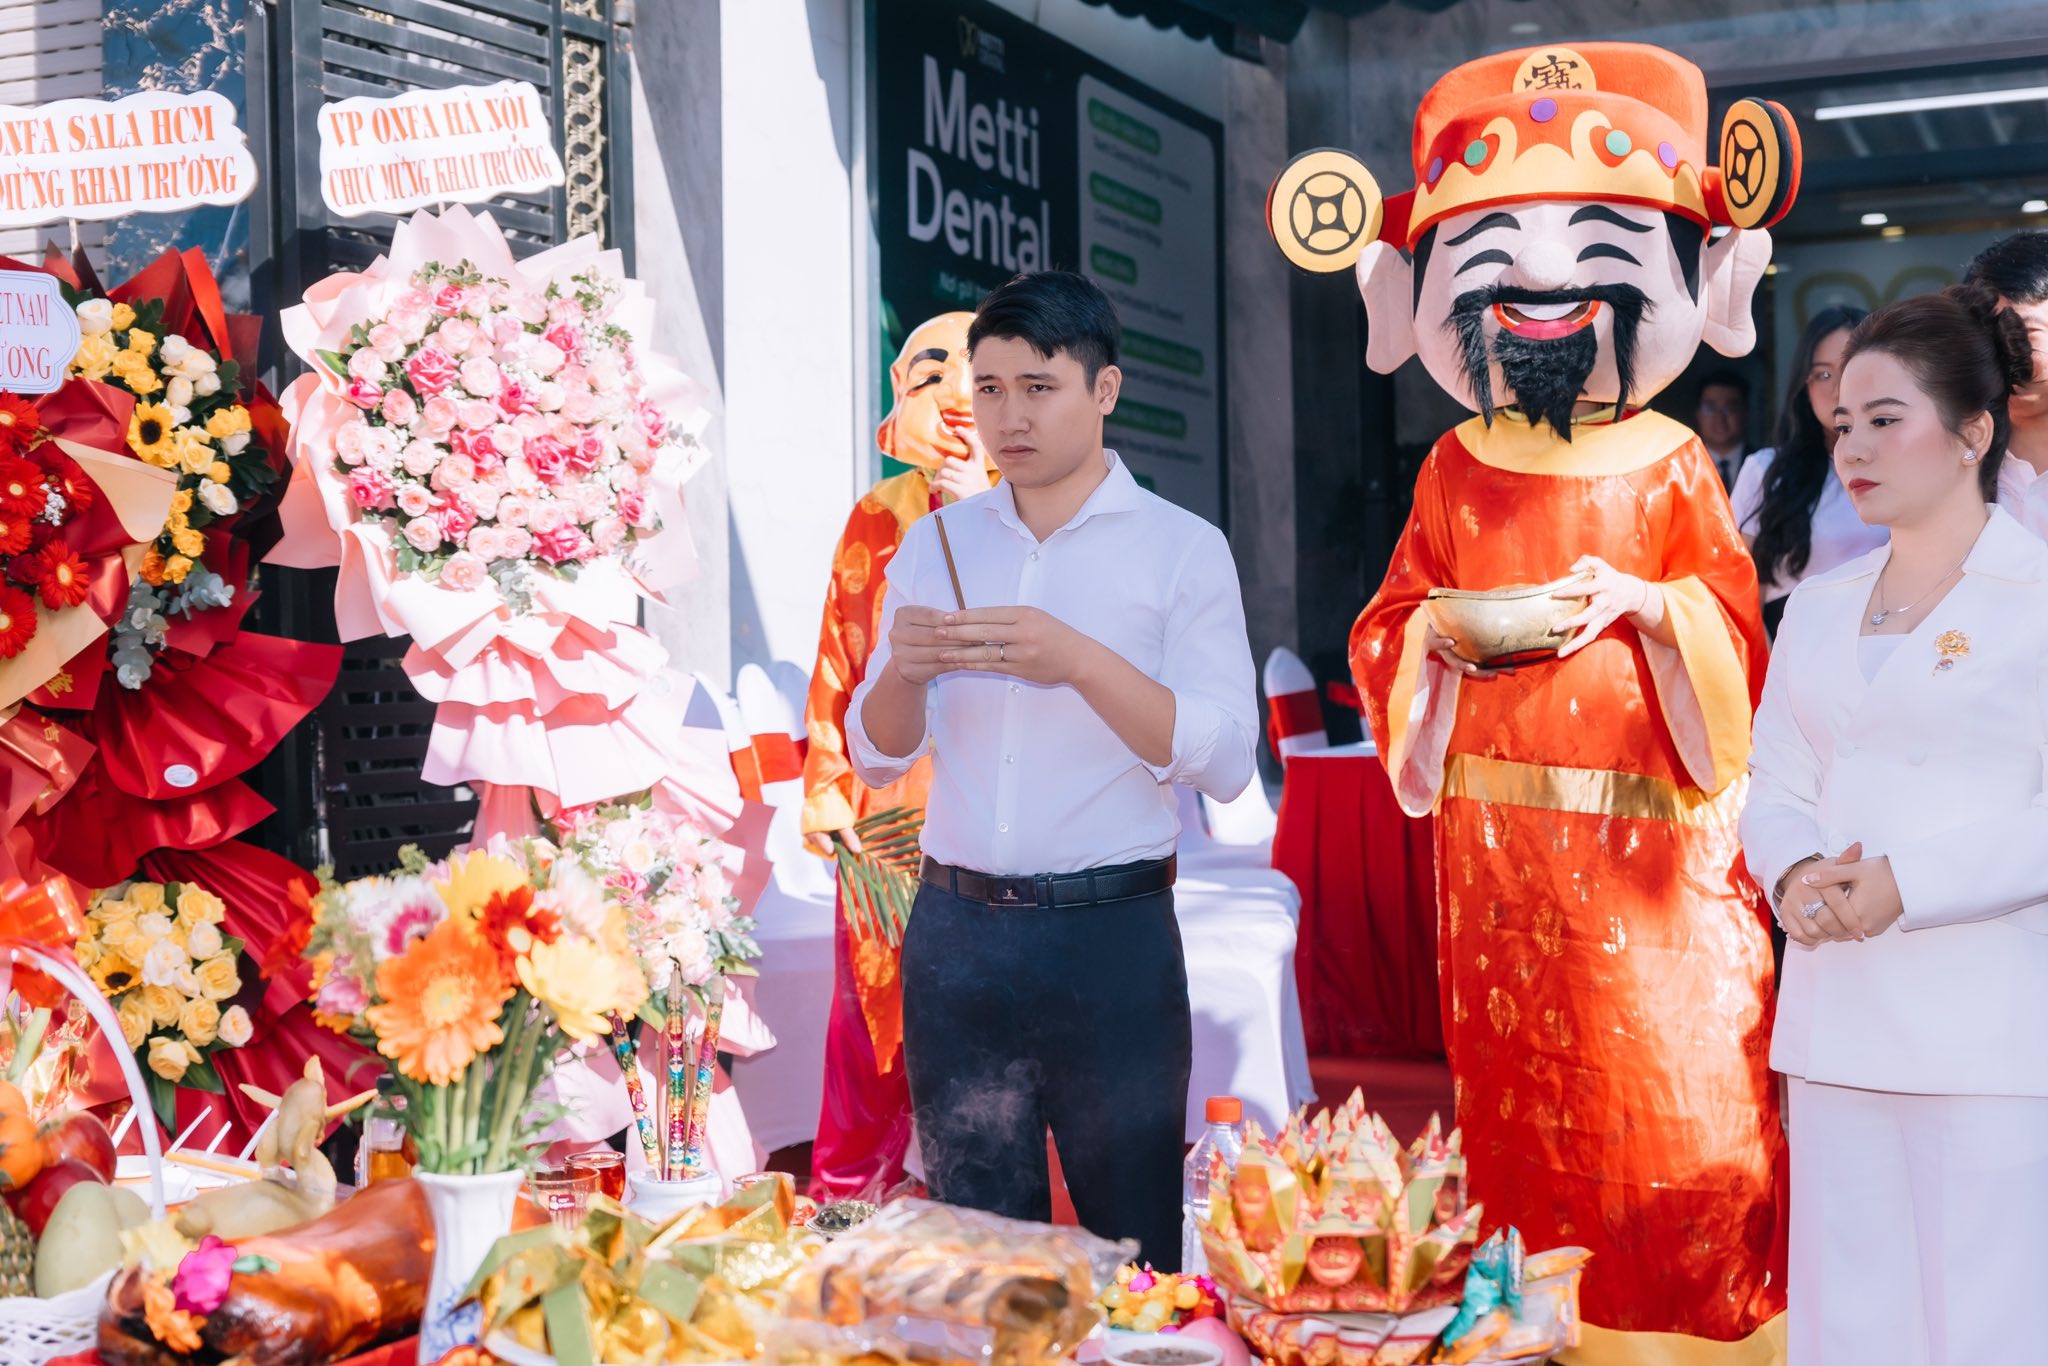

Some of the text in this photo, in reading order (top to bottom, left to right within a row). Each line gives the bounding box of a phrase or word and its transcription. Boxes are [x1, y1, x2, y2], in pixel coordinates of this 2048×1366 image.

[0, 104, 216, 157] NFA SALA HCM
[329, 110, 364, 148] VP
[372, 102, 440, 144] ONFA
[442, 91, 482, 136] HÀ
[924, 53, 1040, 190] Metti
[70, 164, 132, 207] KHAI
[137, 152, 238, 201] TRƯƠNG
[329, 156, 377, 208] CHÚC
[380, 151, 431, 200] MỪNG
[433, 153, 480, 194] KHAI
[907, 146, 1051, 273] Dental
[16, 292, 49, 326] NAM
